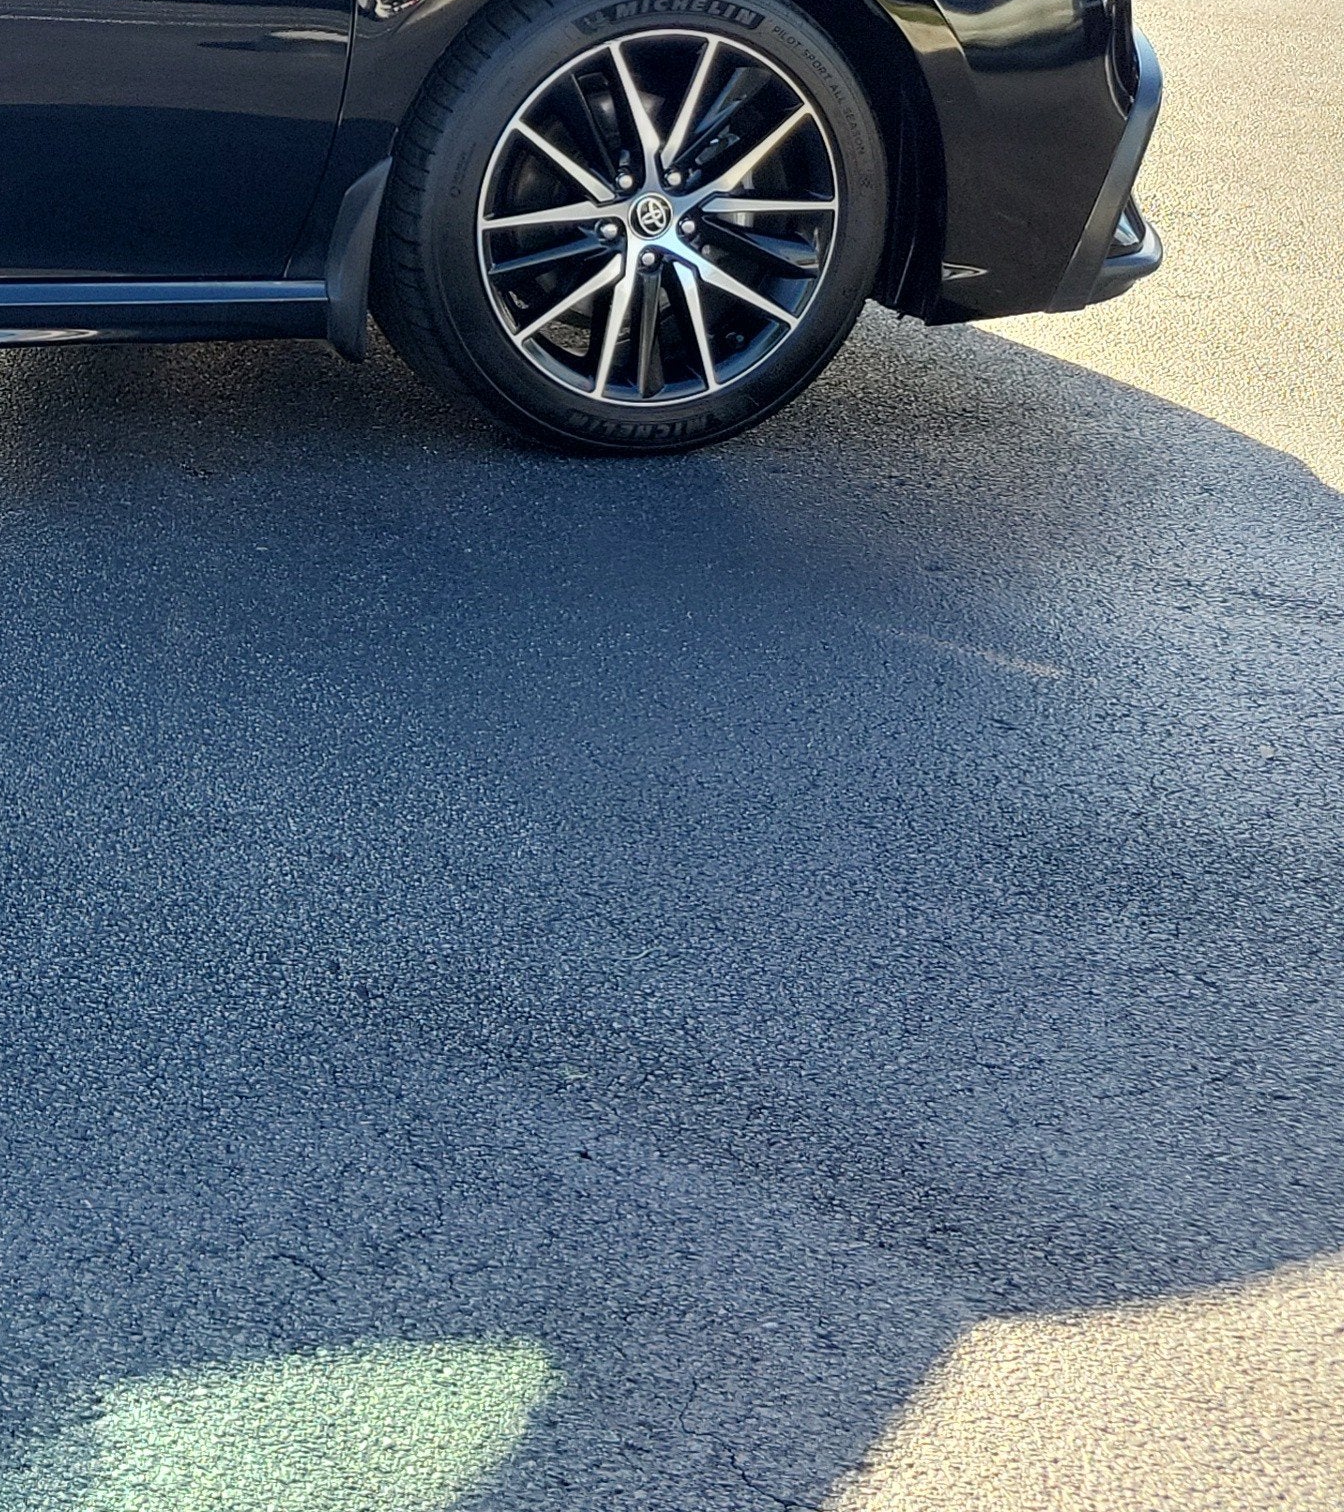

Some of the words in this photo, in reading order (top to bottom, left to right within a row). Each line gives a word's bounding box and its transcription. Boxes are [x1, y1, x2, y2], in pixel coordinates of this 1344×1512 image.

[772, 25, 802, 50] PILOT
[803, 49, 833, 82] SPORT
[829, 83, 844, 104] ALL
